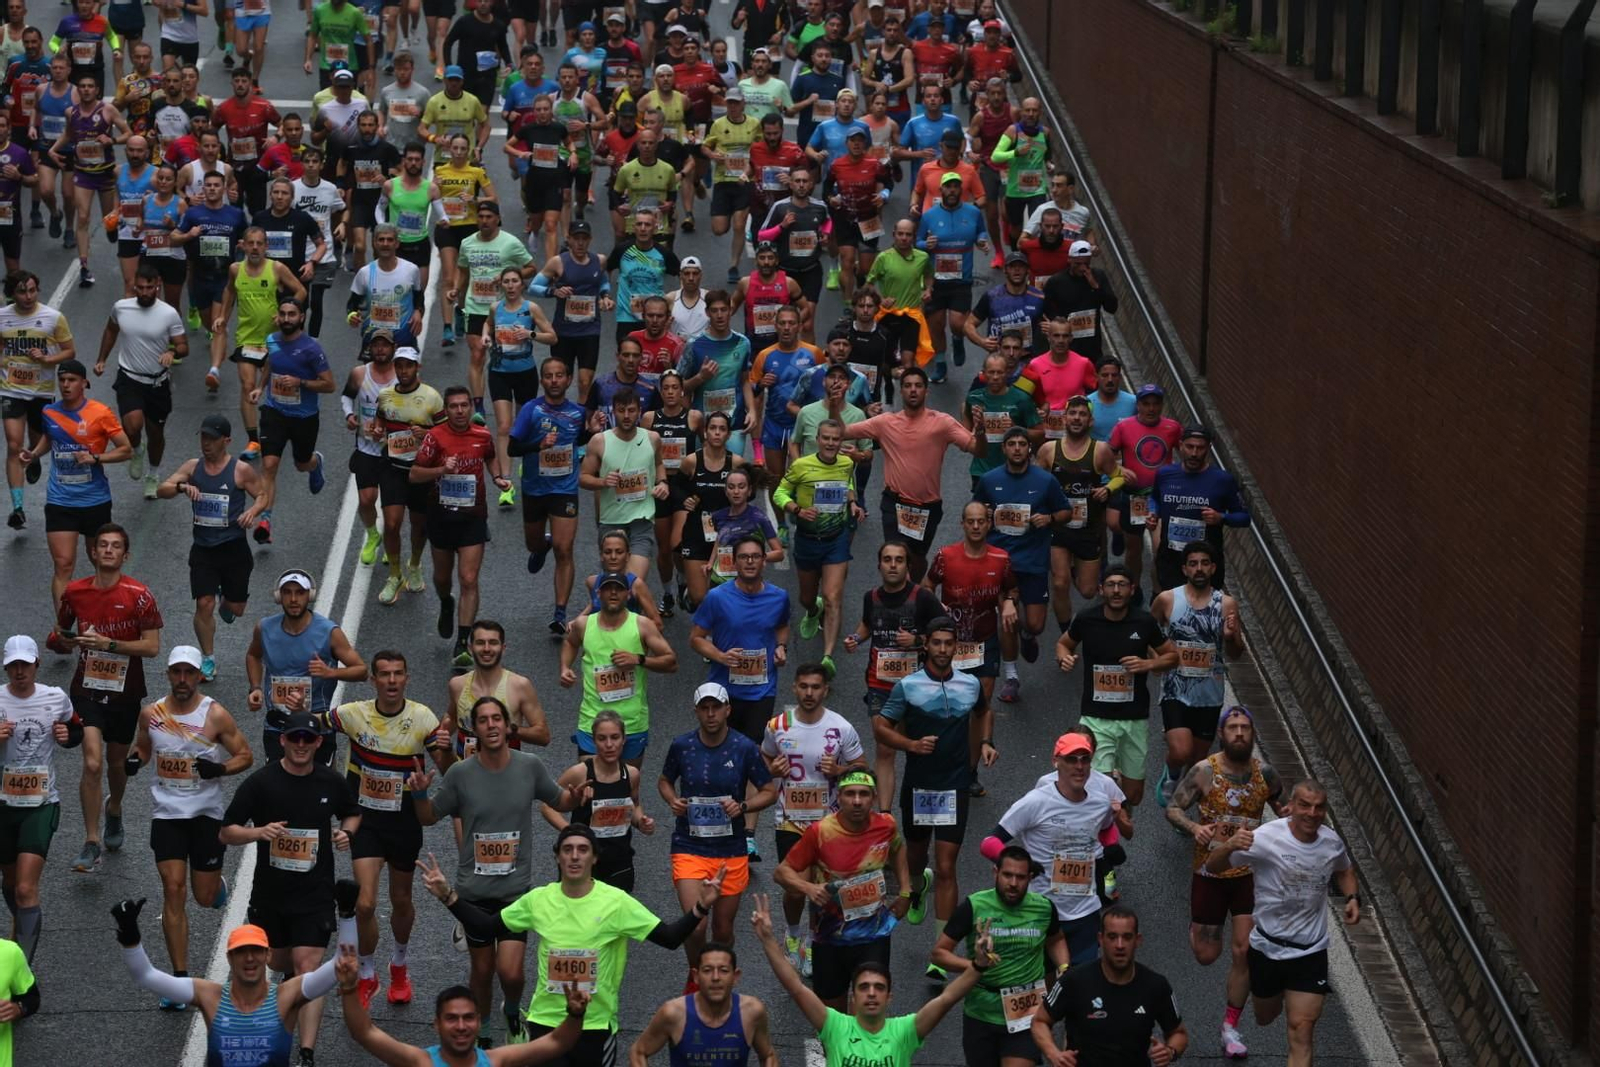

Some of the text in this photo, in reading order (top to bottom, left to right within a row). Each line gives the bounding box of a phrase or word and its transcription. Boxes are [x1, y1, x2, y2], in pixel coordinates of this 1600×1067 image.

[300, 196, 317, 204] JUST
[12, 370, 33, 380] 4209
[393, 438, 414, 450] 4230
[618, 477, 642, 489] 6264
[198, 500, 220, 513] 2390
[1163, 494, 1210, 506] ESTUTIENDA
[1182, 649, 1207, 662] 6157
[91, 661, 117, 674] 5048
[600, 674, 626, 686] 5104
[1099, 675, 1126, 686] 4316
[160, 760, 188, 773] 4242
[9, 776, 38, 789] 4420
[365, 781, 392, 793] 5020
[791, 791, 818, 803] 6371
[277, 838, 307, 853] 6261
[481, 843, 510, 857] 3602
[1059, 864, 1086, 877] 4701
[847, 883, 877, 902] 3949
[554, 960, 587, 974] 4160
[1011, 993, 1038, 1012] 3582
